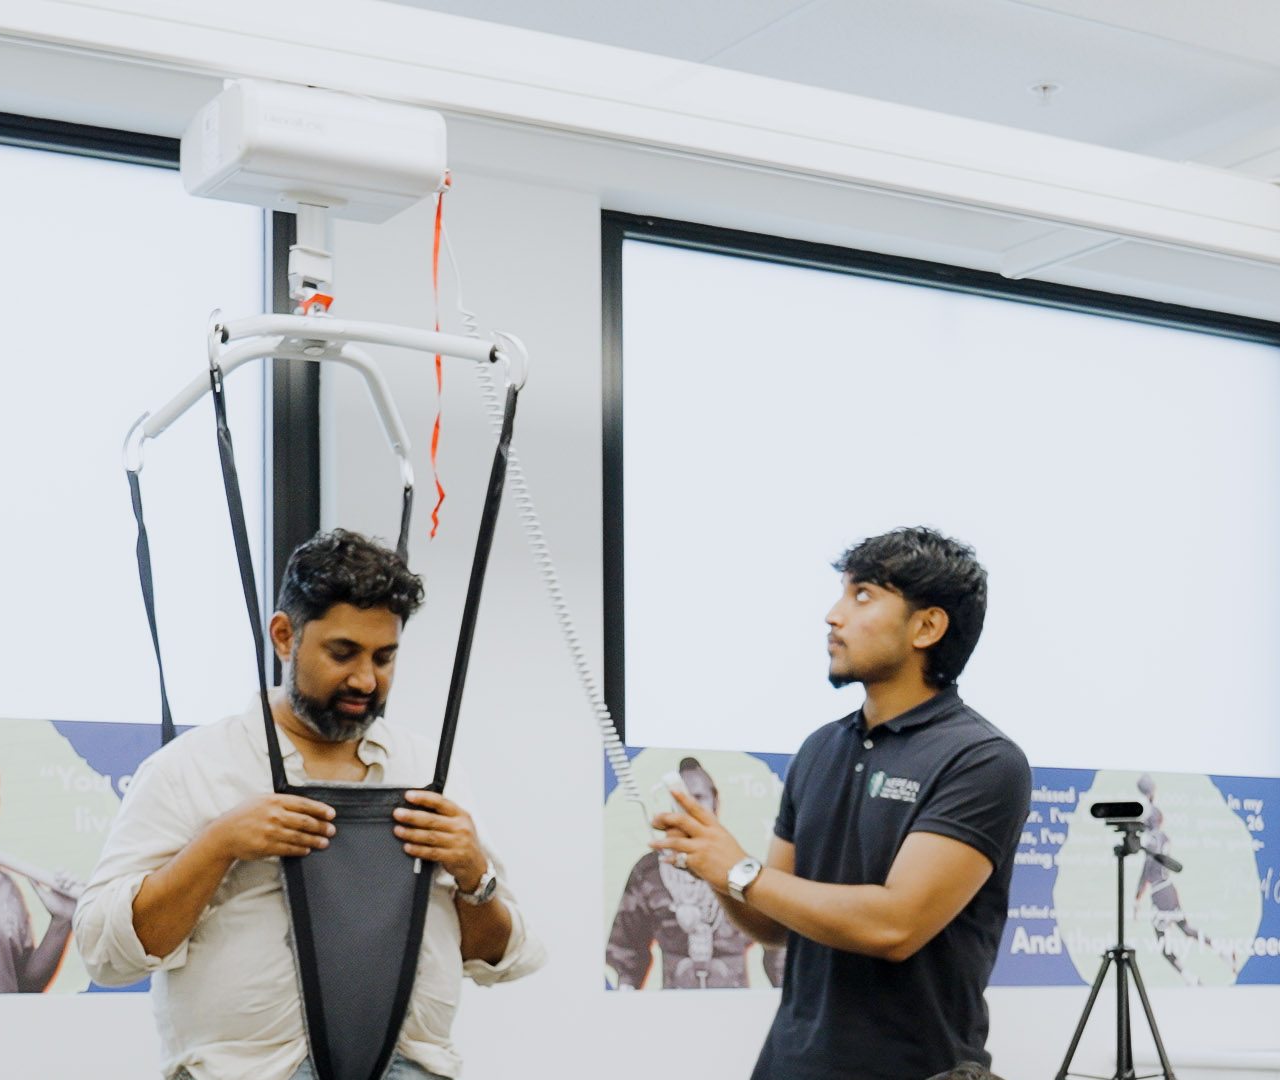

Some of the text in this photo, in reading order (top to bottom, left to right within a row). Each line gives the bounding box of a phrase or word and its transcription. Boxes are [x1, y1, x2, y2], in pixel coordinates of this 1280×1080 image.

[1031, 786, 1075, 804] missed
[1243, 799, 1265, 814] my
[1245, 814, 1265, 831] 26
[1010, 926, 1061, 955] And
[1145, 927, 1193, 956] why
